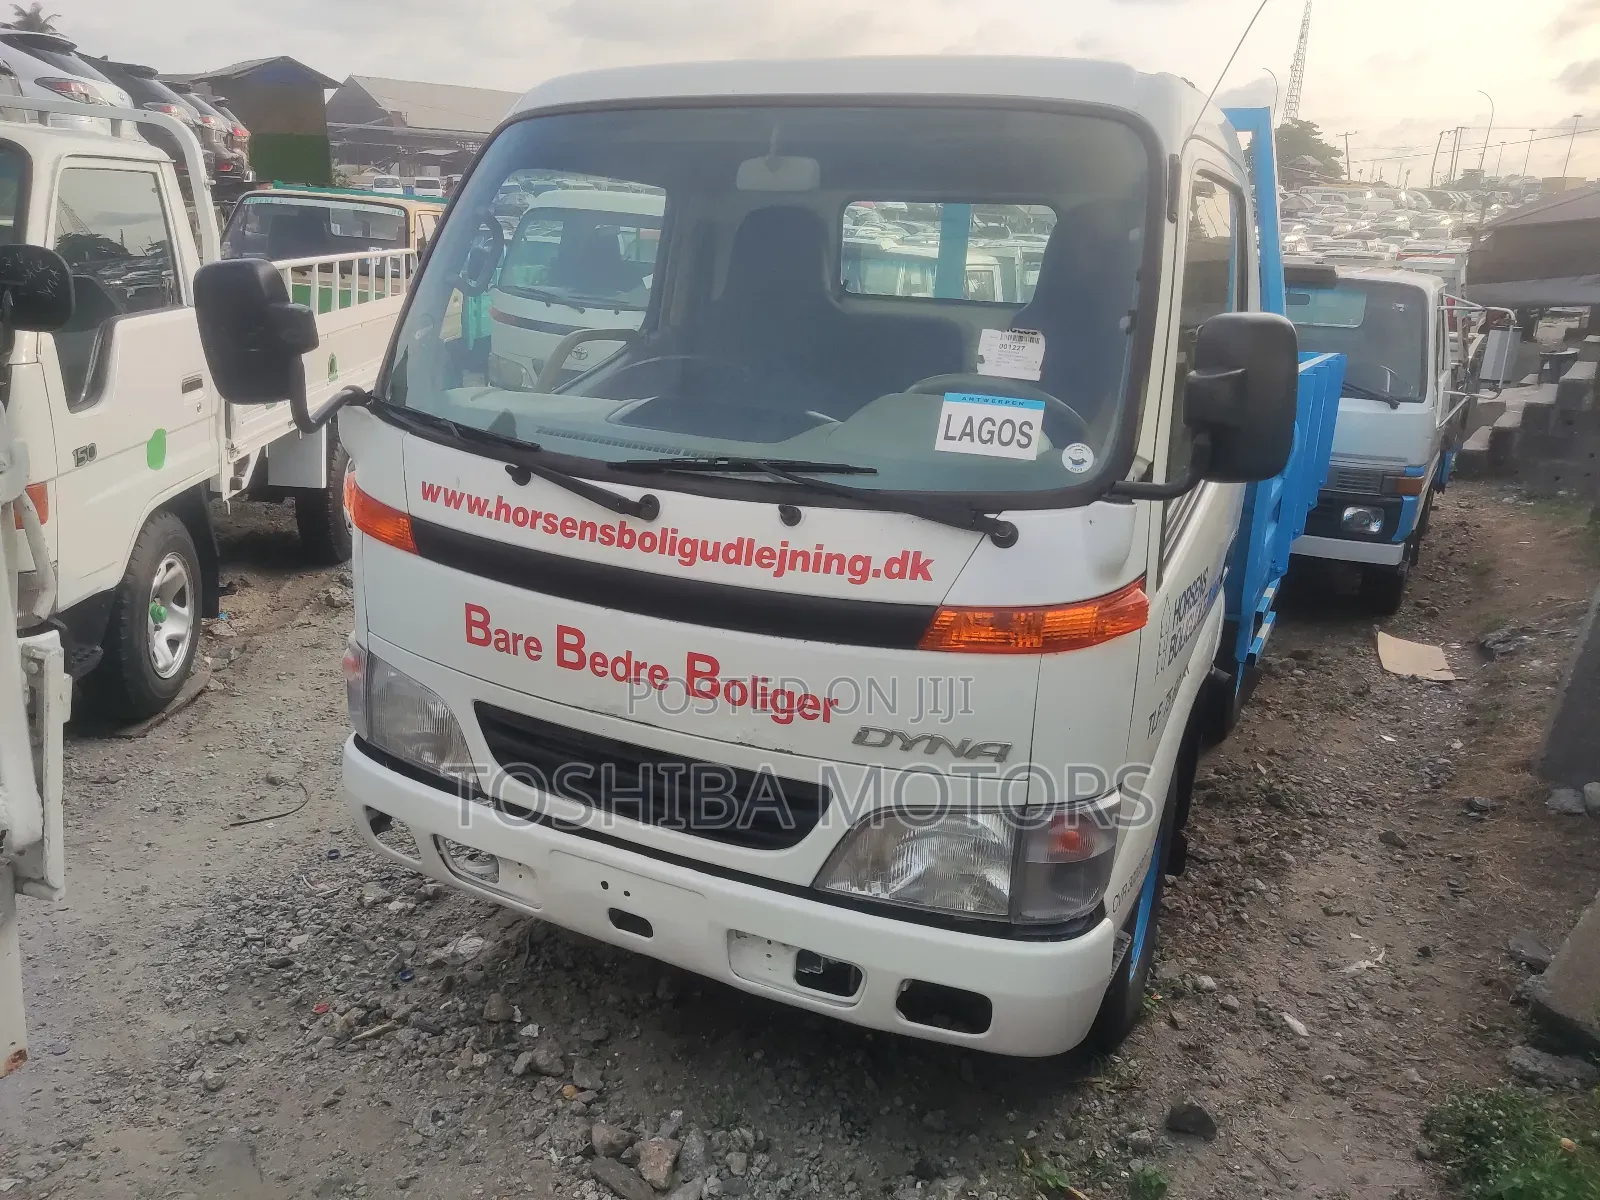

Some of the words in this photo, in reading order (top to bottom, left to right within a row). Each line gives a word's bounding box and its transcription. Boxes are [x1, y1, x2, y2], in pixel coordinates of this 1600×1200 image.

[961, 396, 1025, 406] ANTWERPEN
[943, 414, 1034, 449] LAGOS
[72, 442, 98, 467] 150
[421, 481, 934, 585] www.horsensboligudlejning.dk
[465, 602, 543, 661] Bare
[556, 624, 669, 690] Bedre
[686, 651, 838, 725] Boliger
[851, 725, 1013, 763] DYNA
